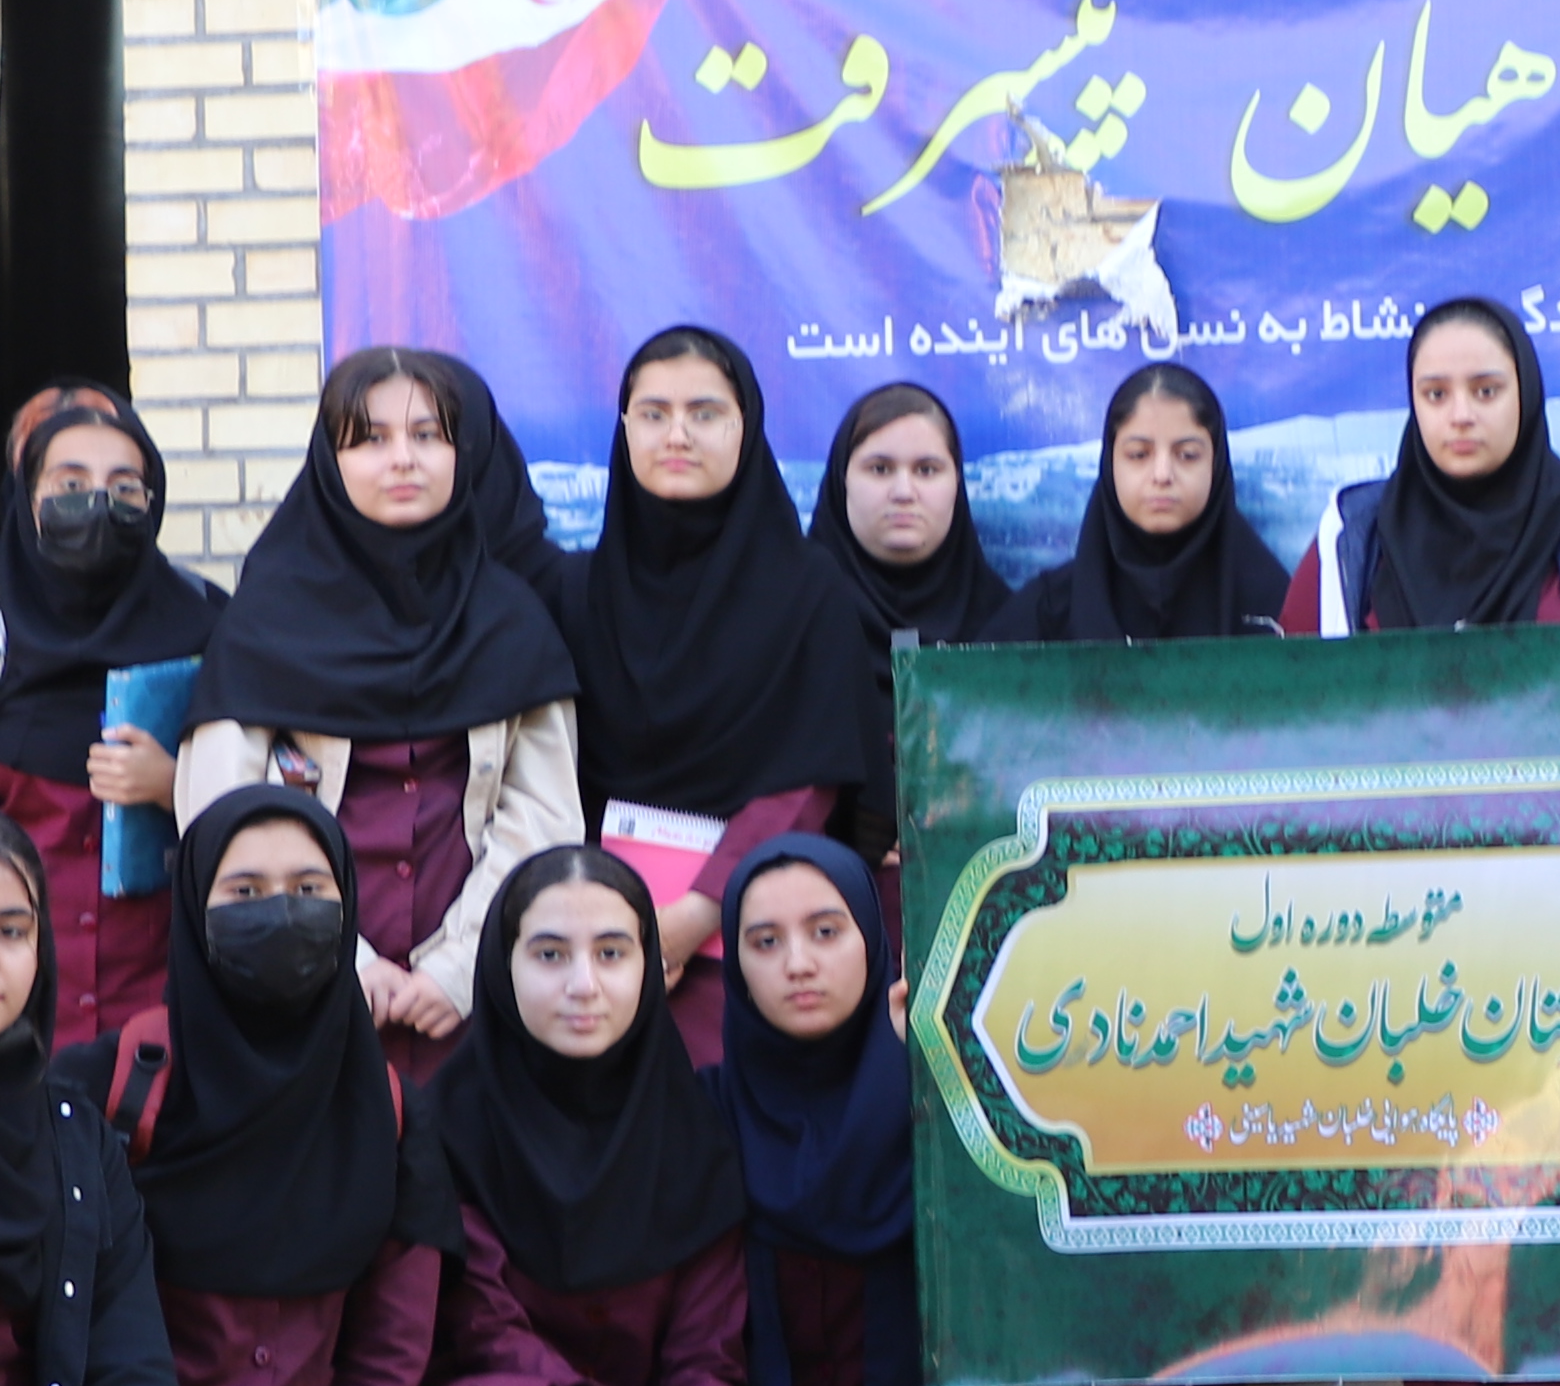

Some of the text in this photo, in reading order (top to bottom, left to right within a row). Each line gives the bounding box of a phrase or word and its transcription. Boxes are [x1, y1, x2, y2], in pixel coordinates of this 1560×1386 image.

[787, 316, 893, 359] است
[1258, 304, 1308, 356] به
[1228, 869, 1295, 954] اول
[1201, 965, 1315, 1090] شهید
[1313, 959, 1465, 1085] خلبان
